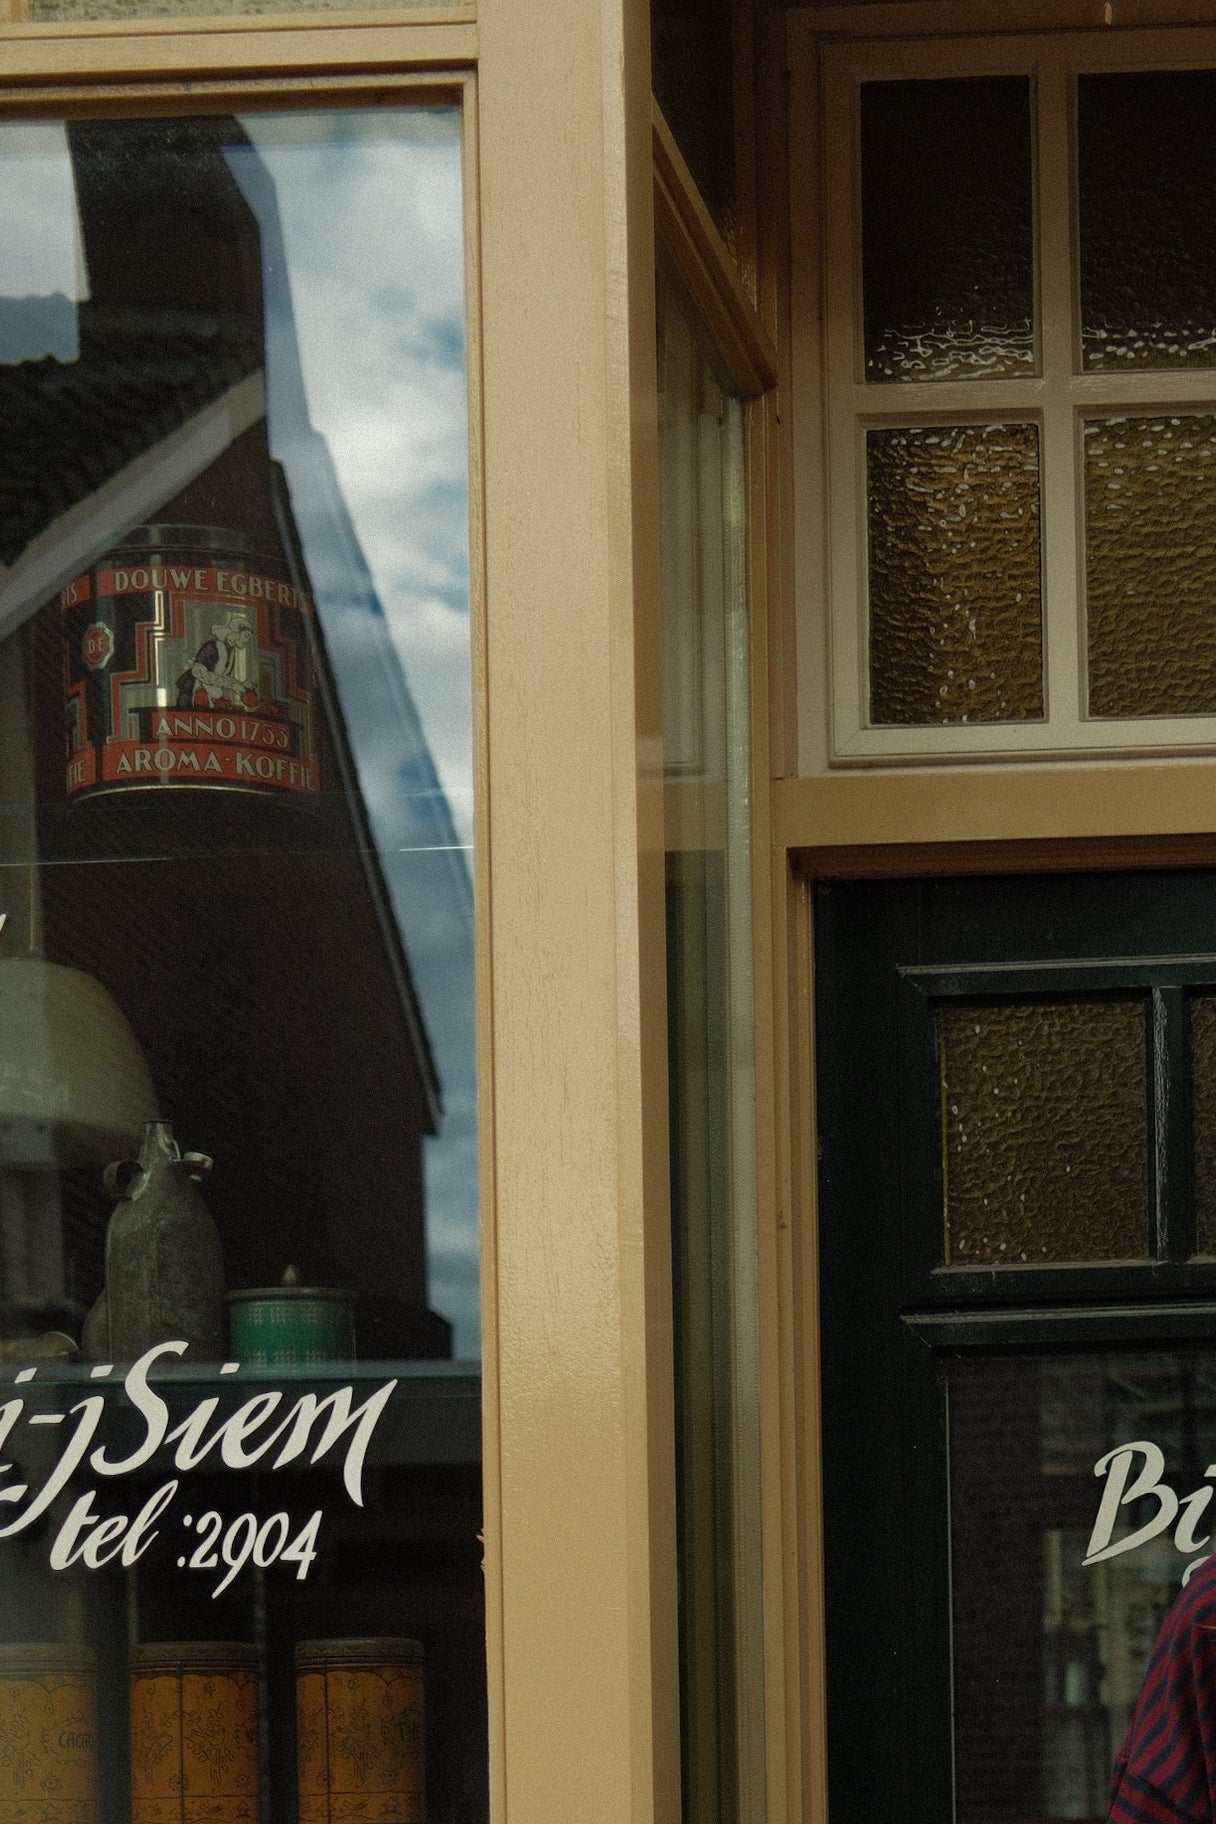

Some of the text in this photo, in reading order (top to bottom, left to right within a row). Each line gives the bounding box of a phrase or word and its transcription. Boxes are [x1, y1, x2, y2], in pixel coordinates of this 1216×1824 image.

[114, 568, 209, 592] DOUWE
[156, 716, 290, 747] ANNO 1753
